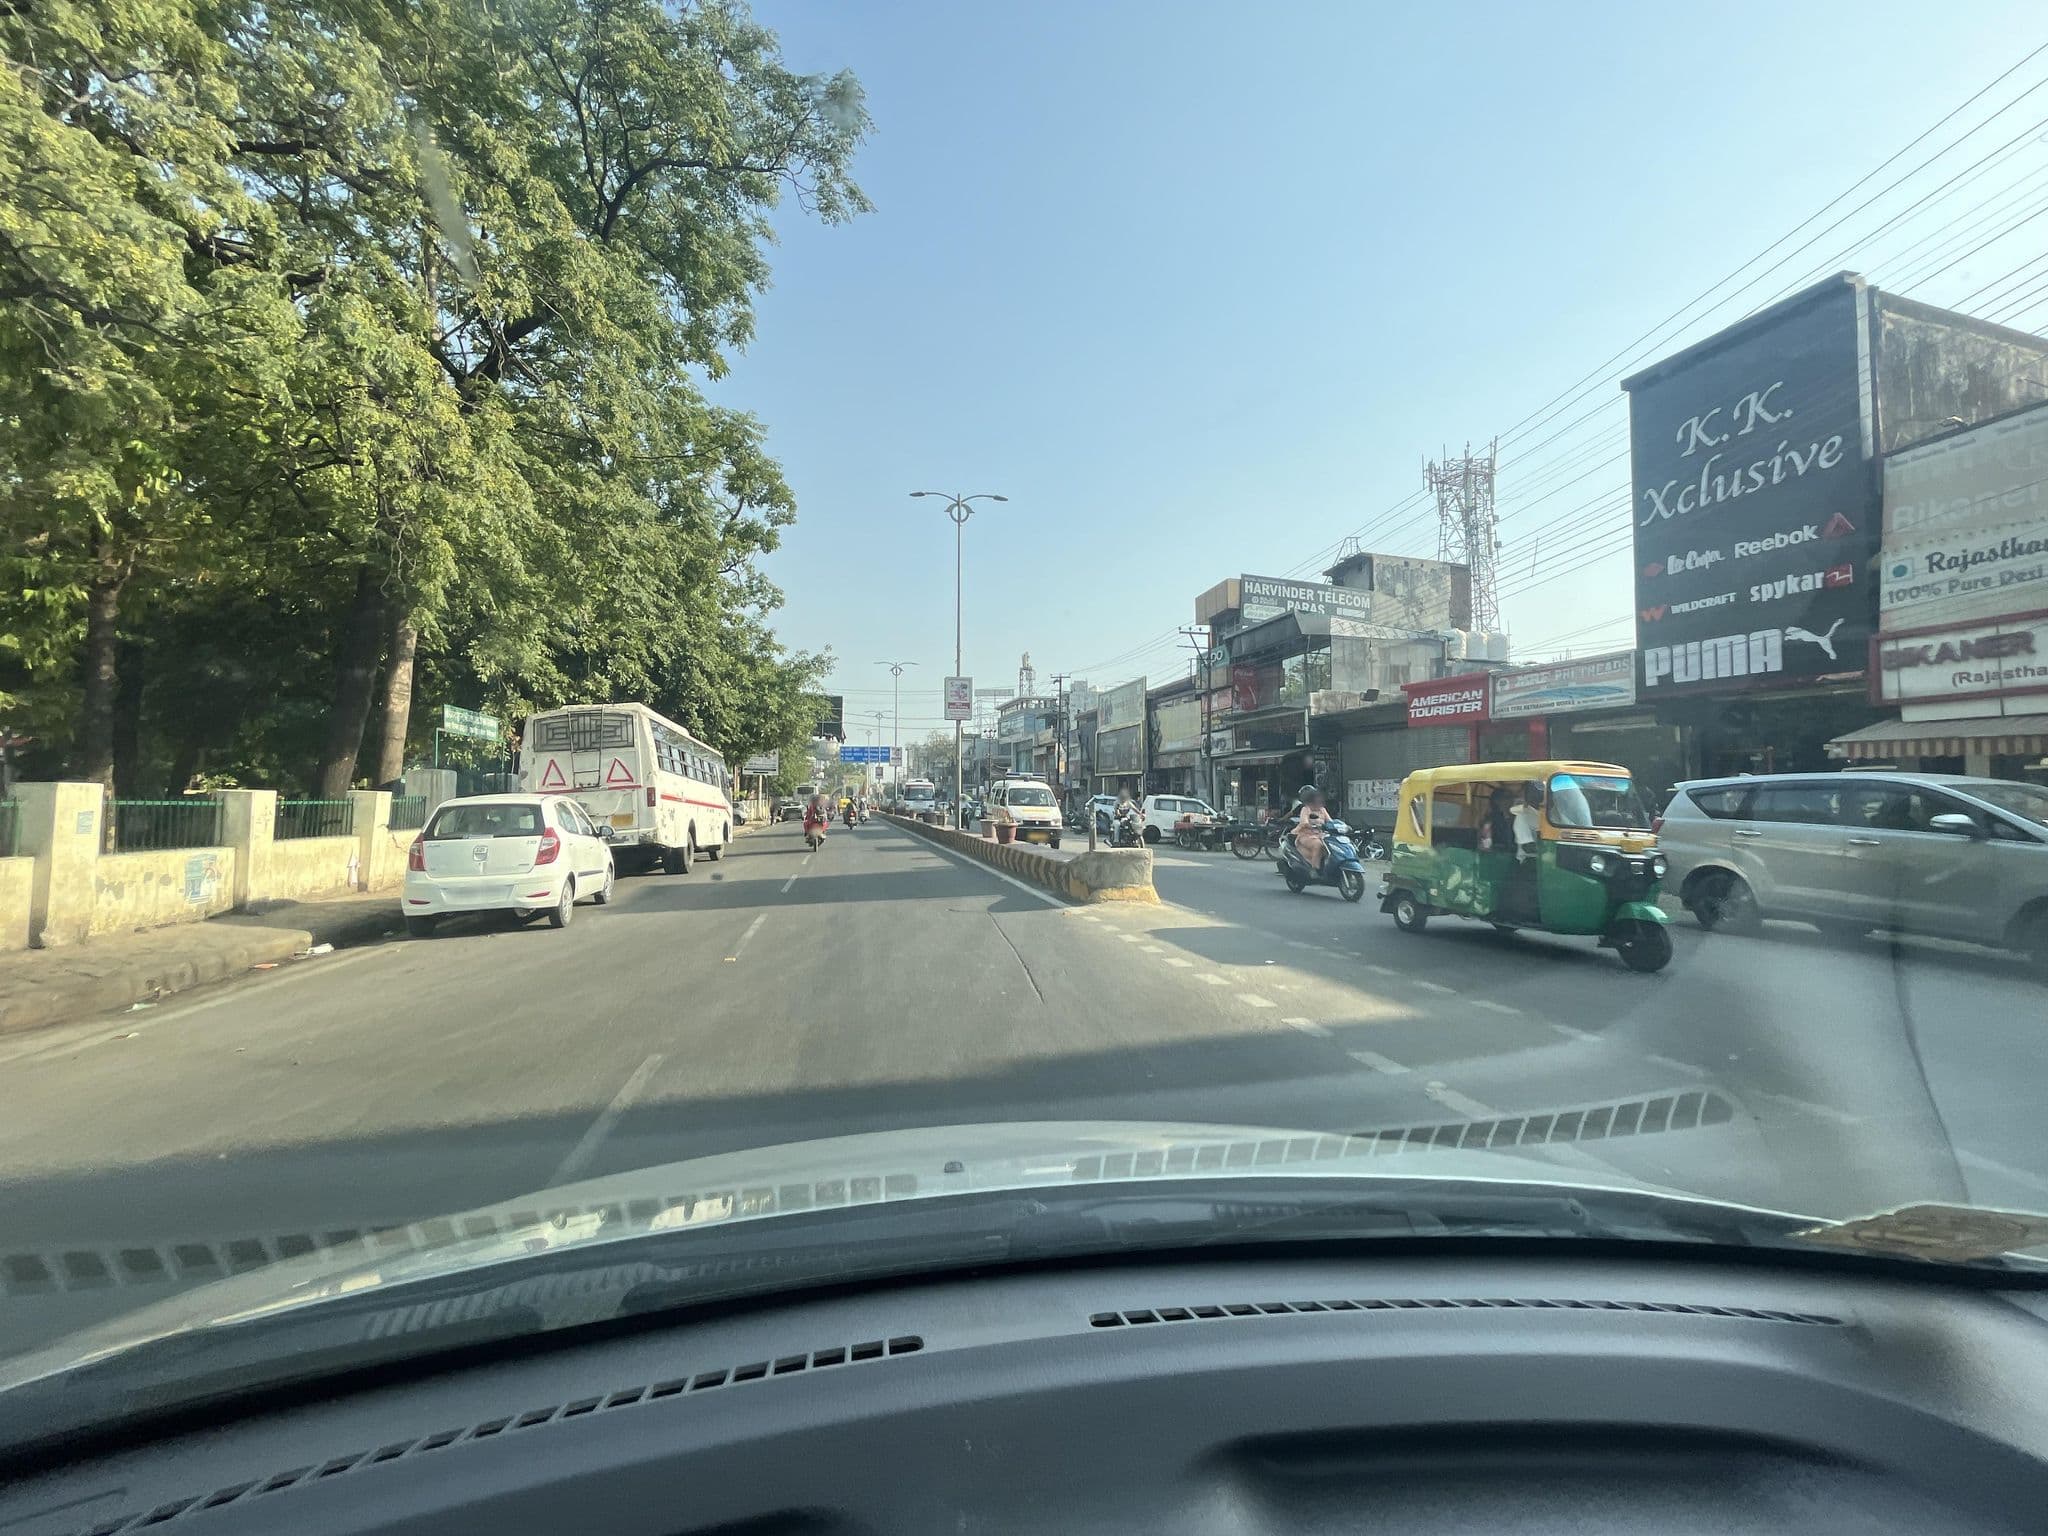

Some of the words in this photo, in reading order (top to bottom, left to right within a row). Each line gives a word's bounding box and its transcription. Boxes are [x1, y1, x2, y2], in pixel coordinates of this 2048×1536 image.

[1640, 433, 1845, 527] Xclusive
[1734, 525, 1819, 559] Reebok
[1244, 581, 1314, 601] HARVINDER
[1316, 590, 1371, 609] TELECOM
[1750, 571, 1824, 602] spykar
[1888, 585, 1942, 604] 100%
[1947, 576, 1992, 594] Pure
[1999, 564, 2044, 586] Desi
[1671, 592, 1737, 614] WILDCRAFT
[1644, 628, 1783, 687] PUMA
[1409, 701, 1482, 719] TOURISTER
